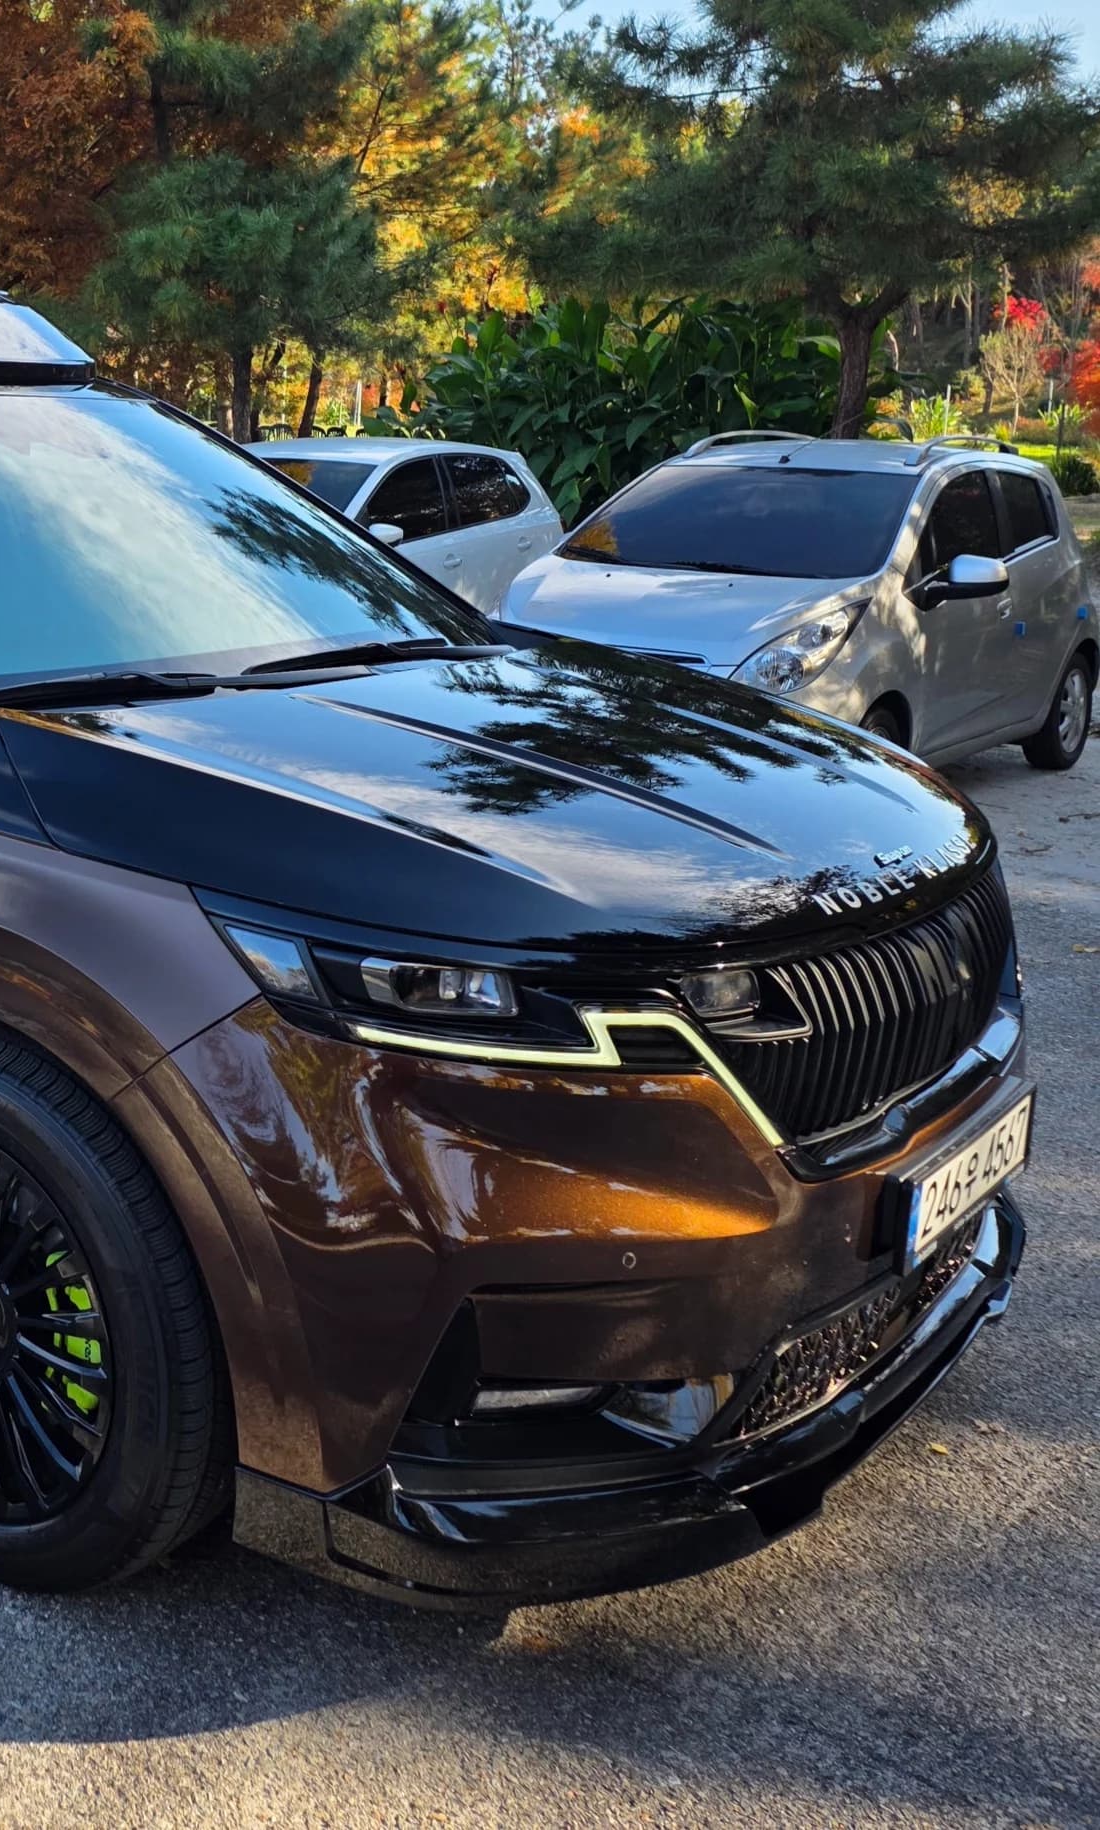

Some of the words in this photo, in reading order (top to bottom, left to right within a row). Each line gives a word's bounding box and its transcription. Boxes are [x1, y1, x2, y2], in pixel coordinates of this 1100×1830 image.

[812, 869, 916, 915] NOBLE
[921, 1152, 978, 1238] 246우
[983, 1106, 1028, 1183] 4567
